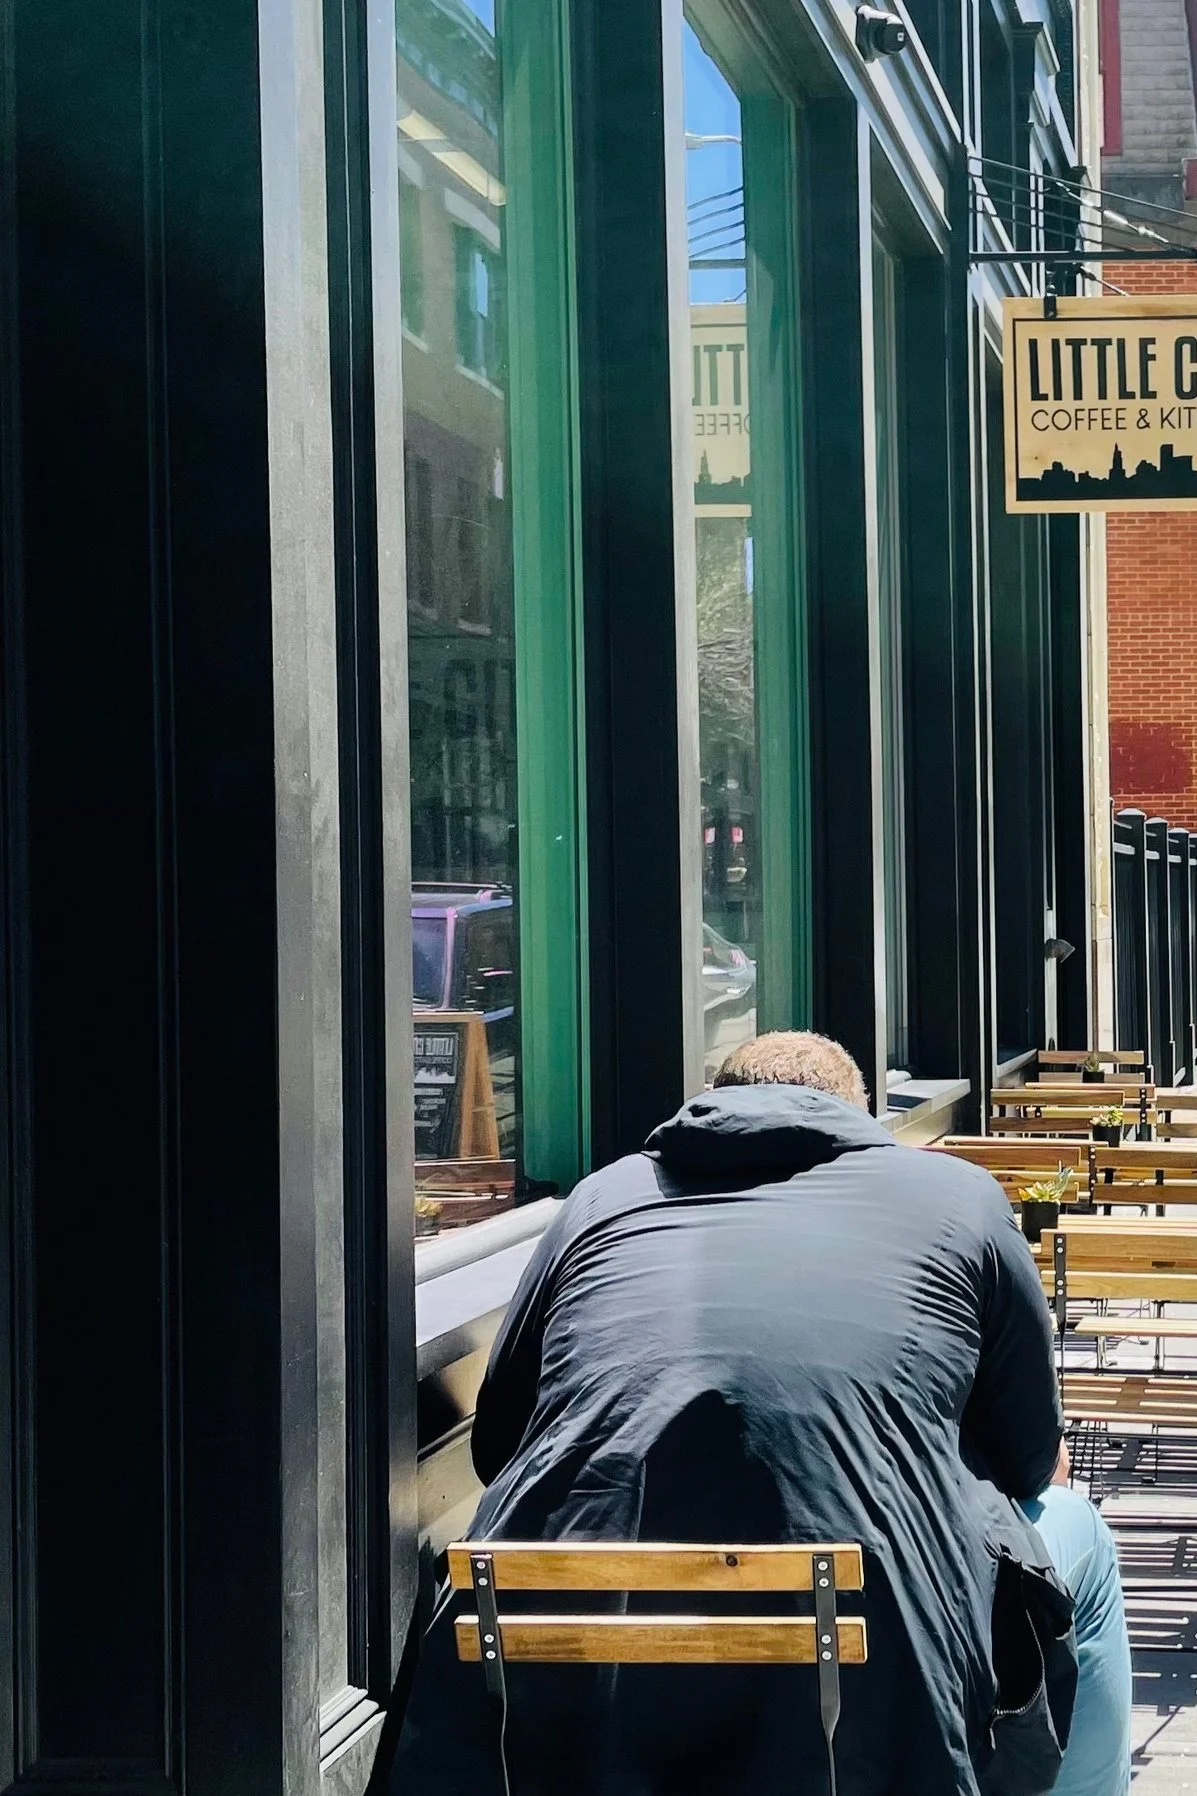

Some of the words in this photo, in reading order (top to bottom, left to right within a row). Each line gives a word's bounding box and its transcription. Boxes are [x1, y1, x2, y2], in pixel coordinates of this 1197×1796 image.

[1028, 337, 1157, 401] LITTLE
[1031, 408, 1127, 431] COFFEE
[1136, 408, 1150, 429] &
